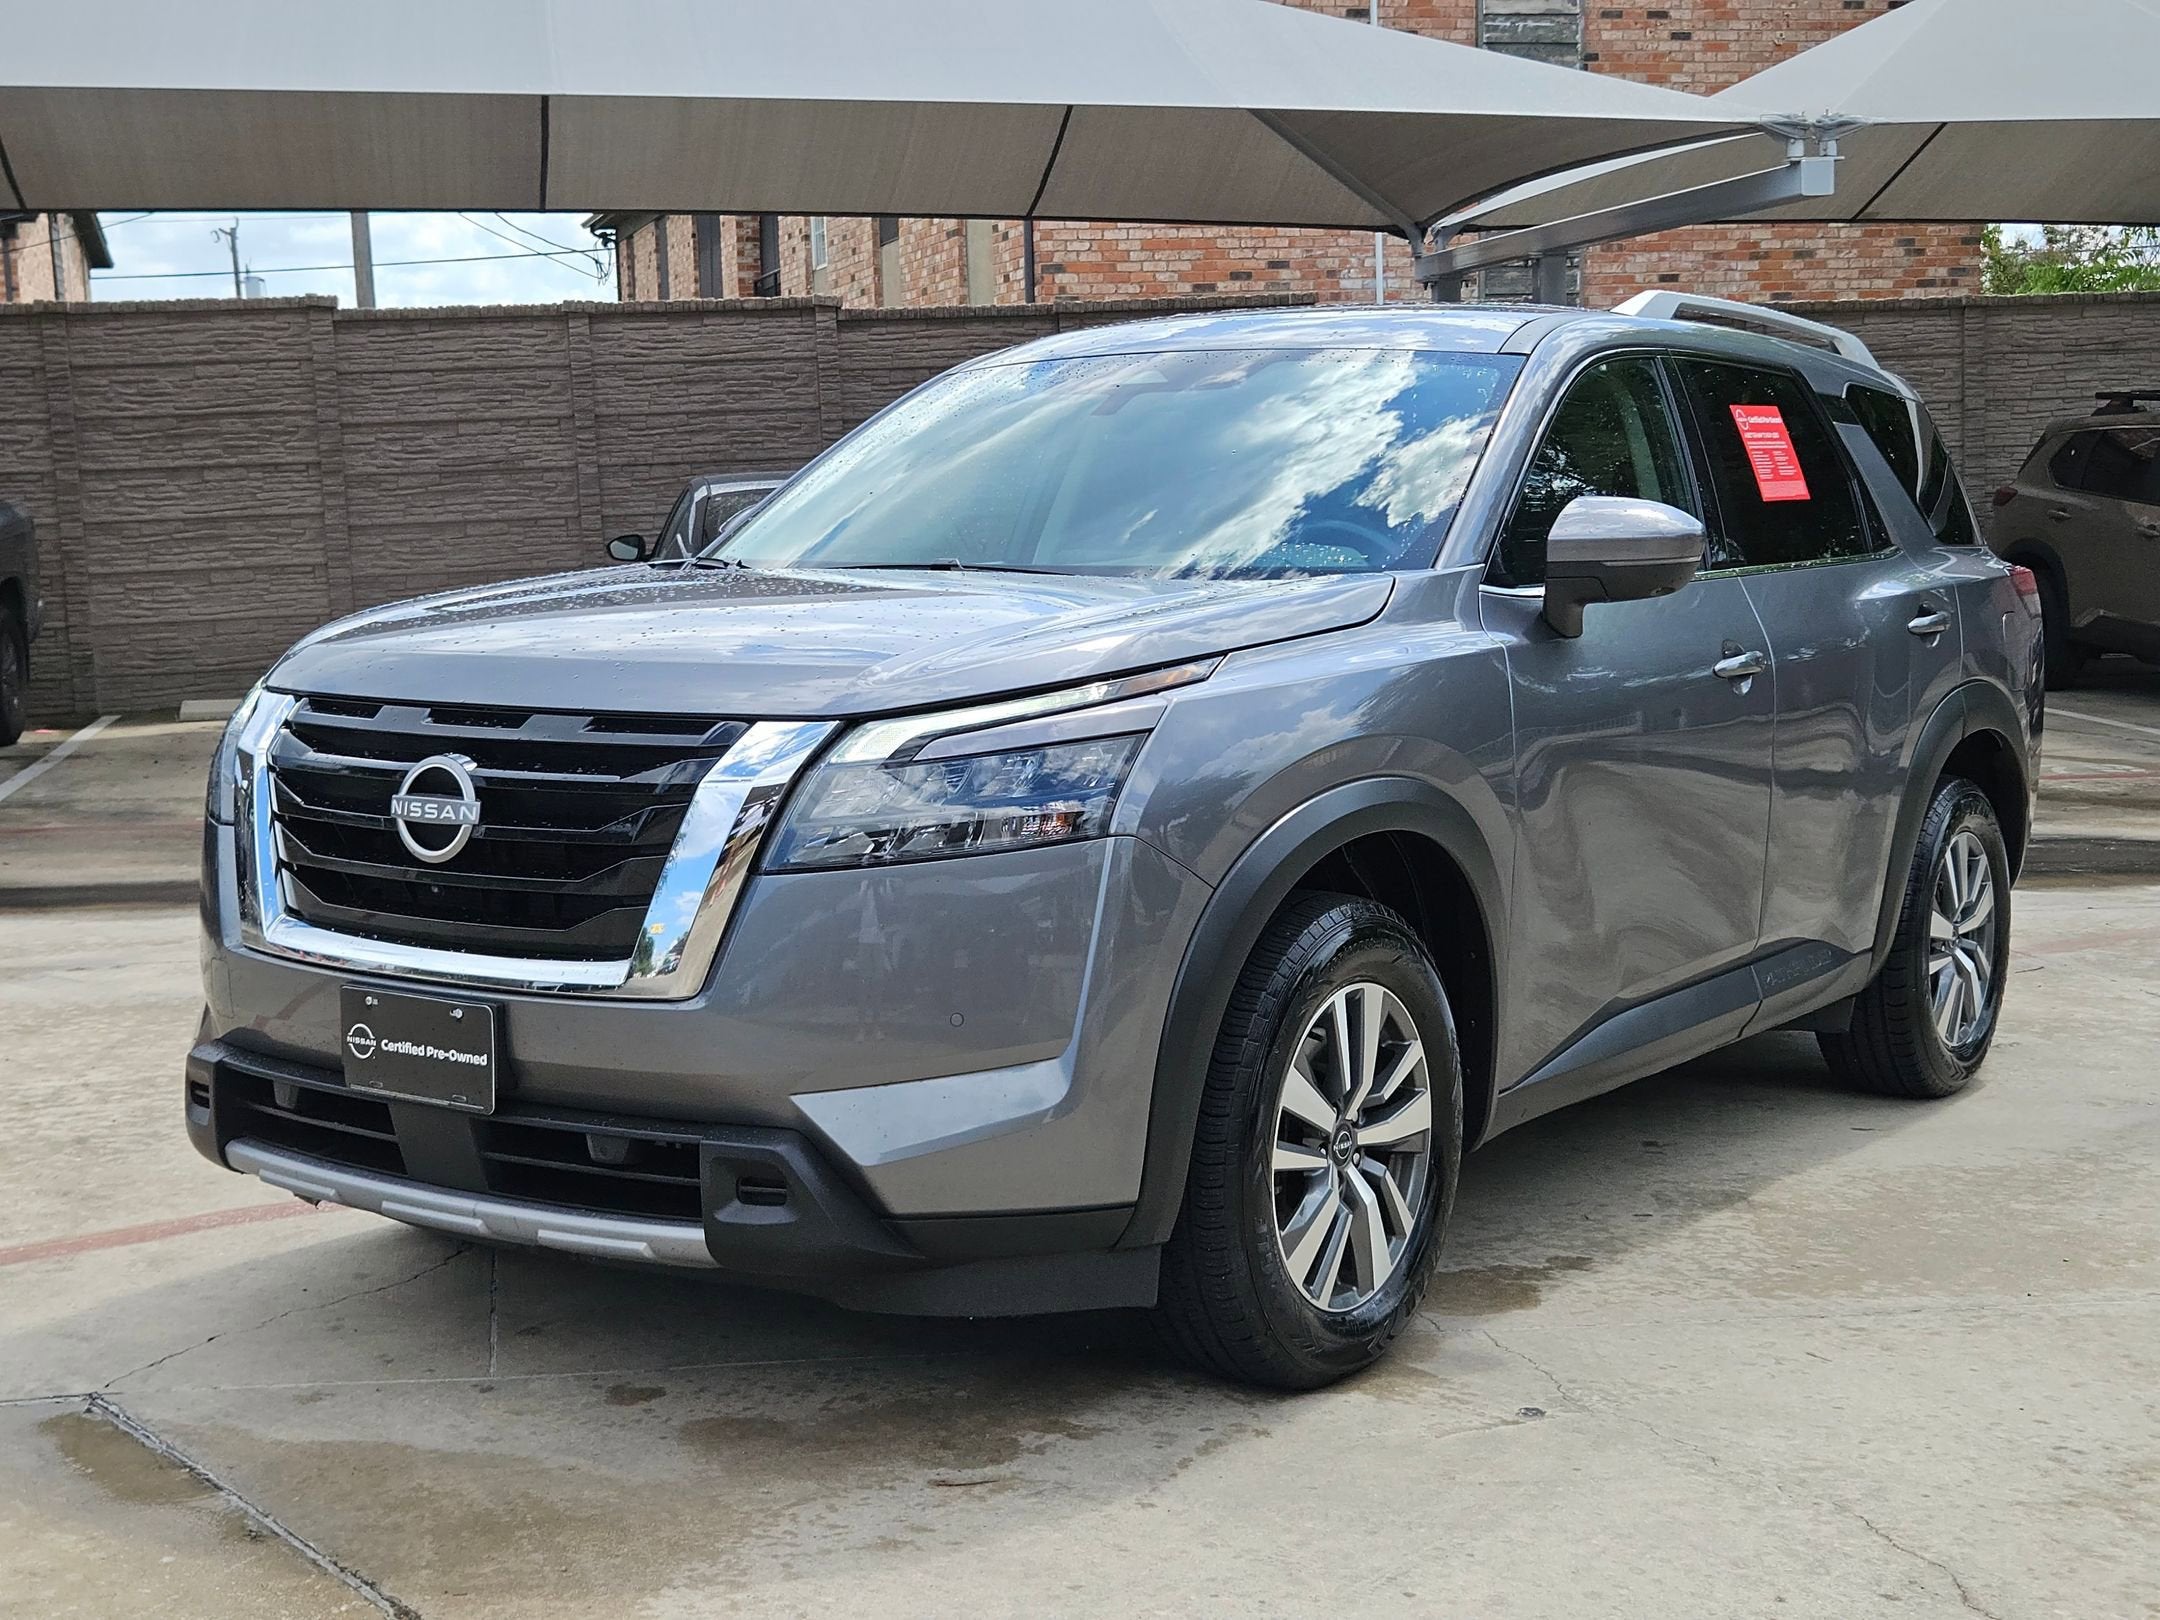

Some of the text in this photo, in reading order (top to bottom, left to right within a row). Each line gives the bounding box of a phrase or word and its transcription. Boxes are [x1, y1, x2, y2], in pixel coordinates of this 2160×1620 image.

[391, 799, 477, 820] NISSAN
[346, 1035, 376, 1046] NISSAN
[381, 1039, 488, 1066] Certified Pre-Owned
